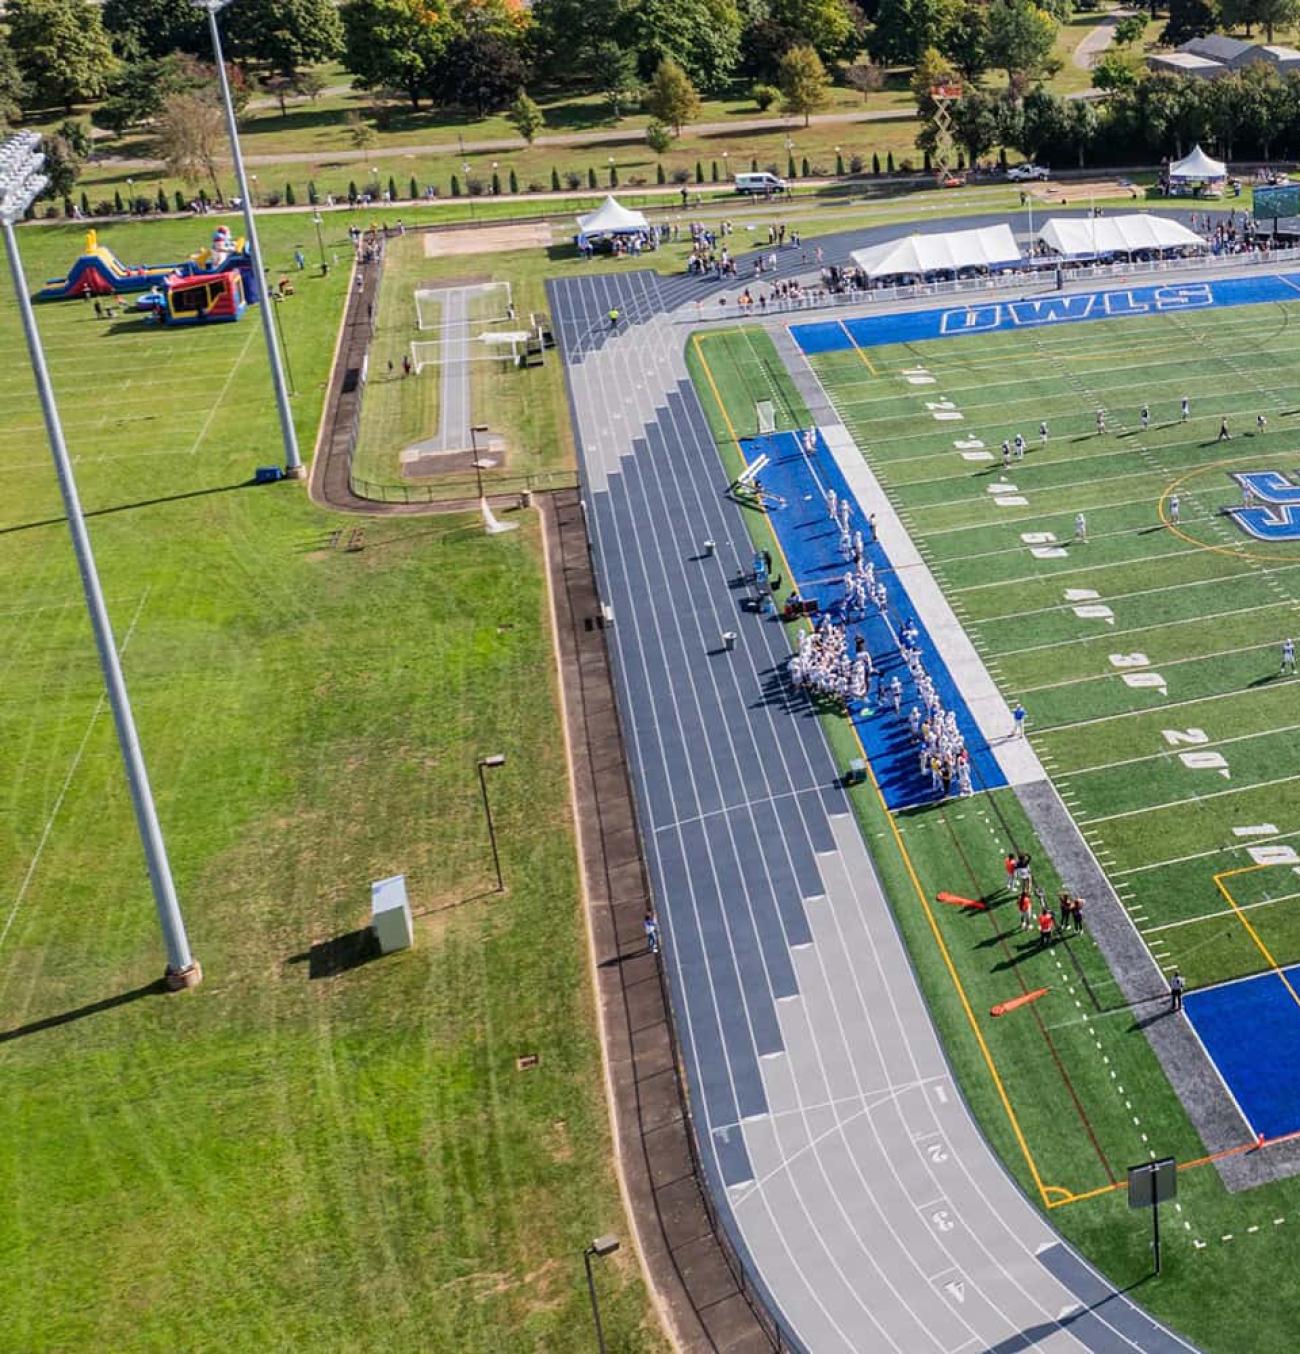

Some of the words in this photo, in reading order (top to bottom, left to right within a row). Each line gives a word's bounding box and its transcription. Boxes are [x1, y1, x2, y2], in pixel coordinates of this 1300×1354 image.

[940, 284, 1213, 335] OWLS
[1161, 727, 1229, 769] 20
[927, 1144, 948, 1163] 2
[932, 1210, 954, 1232] 3
[943, 1280, 965, 1304] 4
